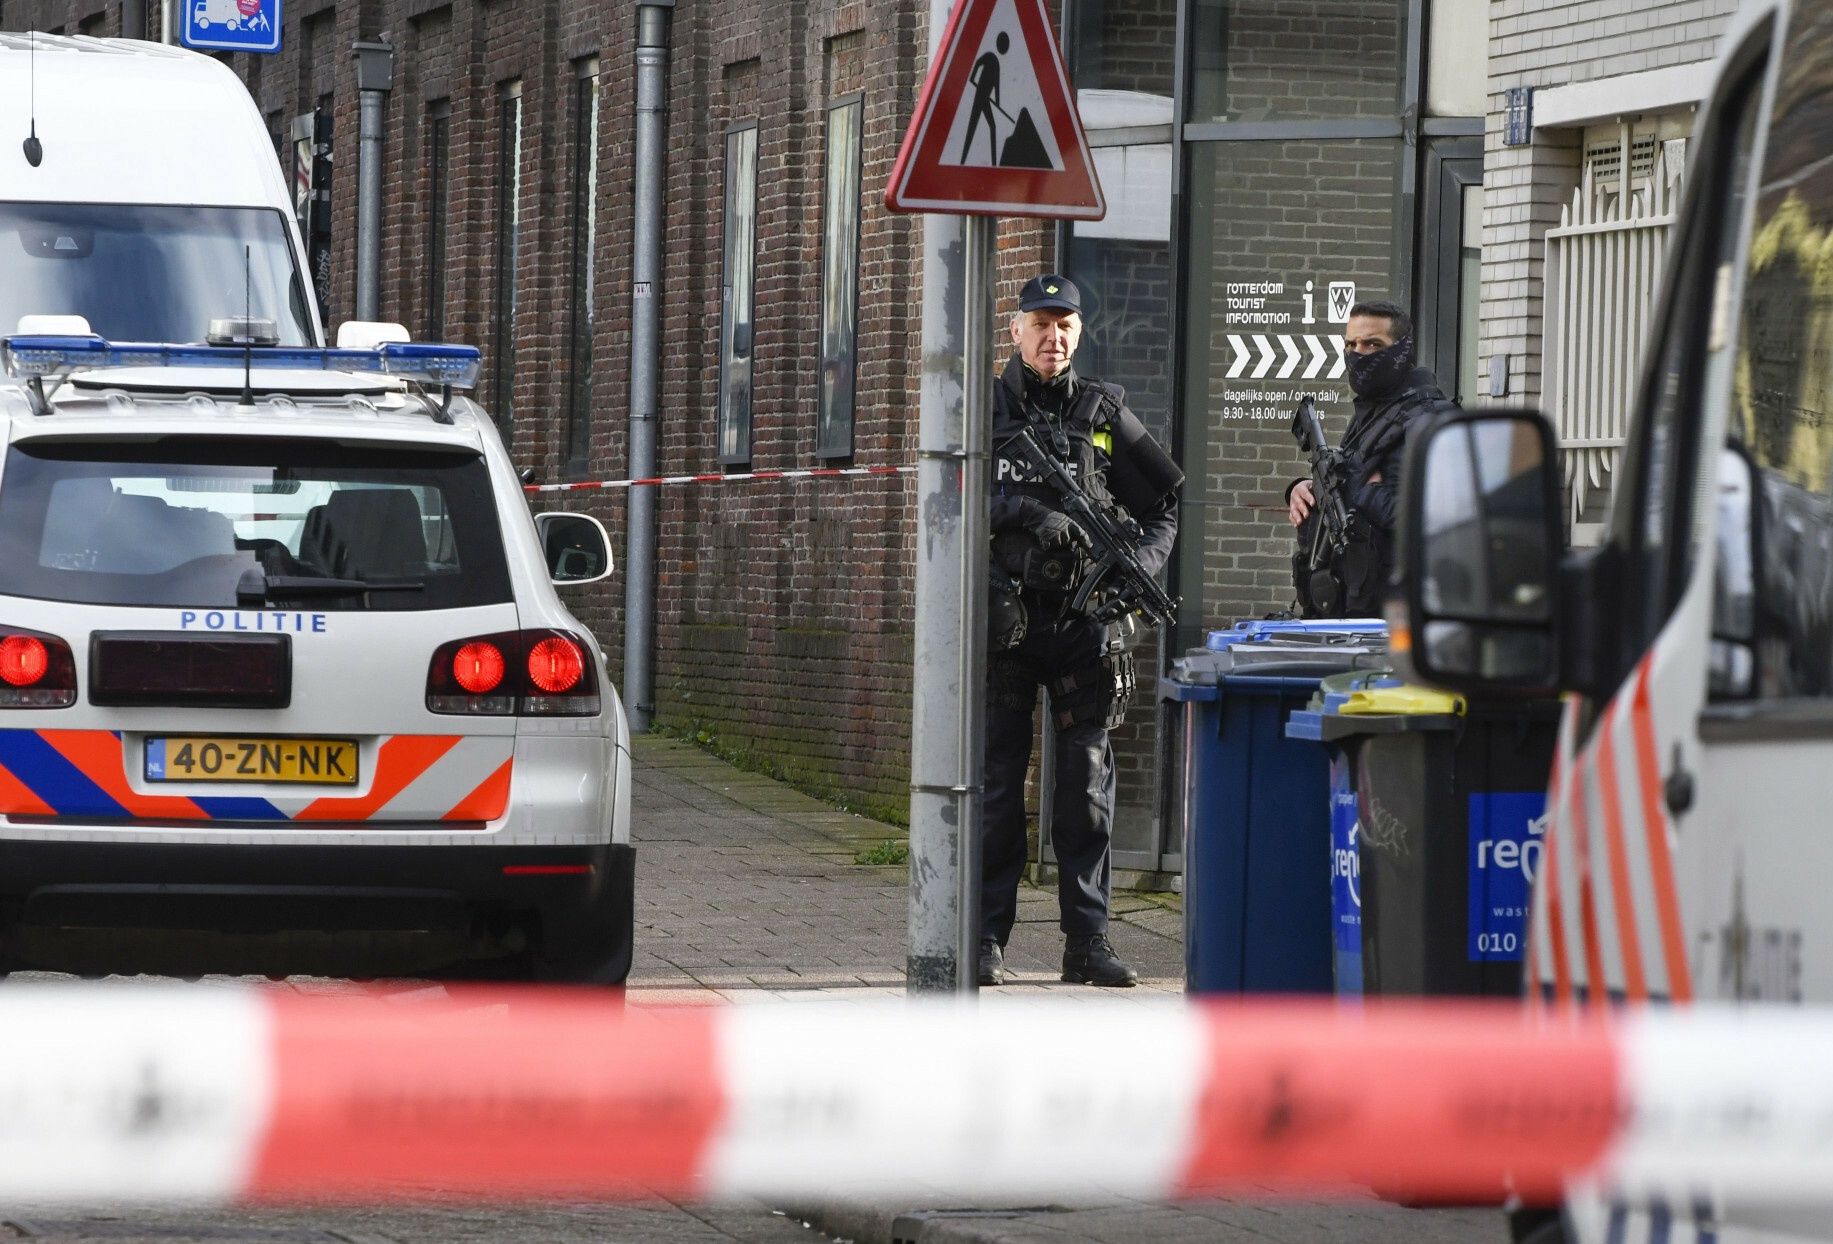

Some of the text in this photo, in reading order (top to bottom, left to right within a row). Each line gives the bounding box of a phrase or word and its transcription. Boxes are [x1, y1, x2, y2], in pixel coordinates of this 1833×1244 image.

[1224, 389, 1263, 403] dagelijks
[1265, 391, 1287, 403] open
[1318, 389, 1340, 403] daily
[1223, 407, 1244, 419] 9.30
[1251, 407, 1276, 419] 18.00
[1277, 410, 1293, 420] uur
[181, 611, 326, 632] POLITIE
[148, 762, 163, 773] NL
[173, 743, 346, 776] 40-ZN-NK
[1478, 932, 1516, 952] 010
